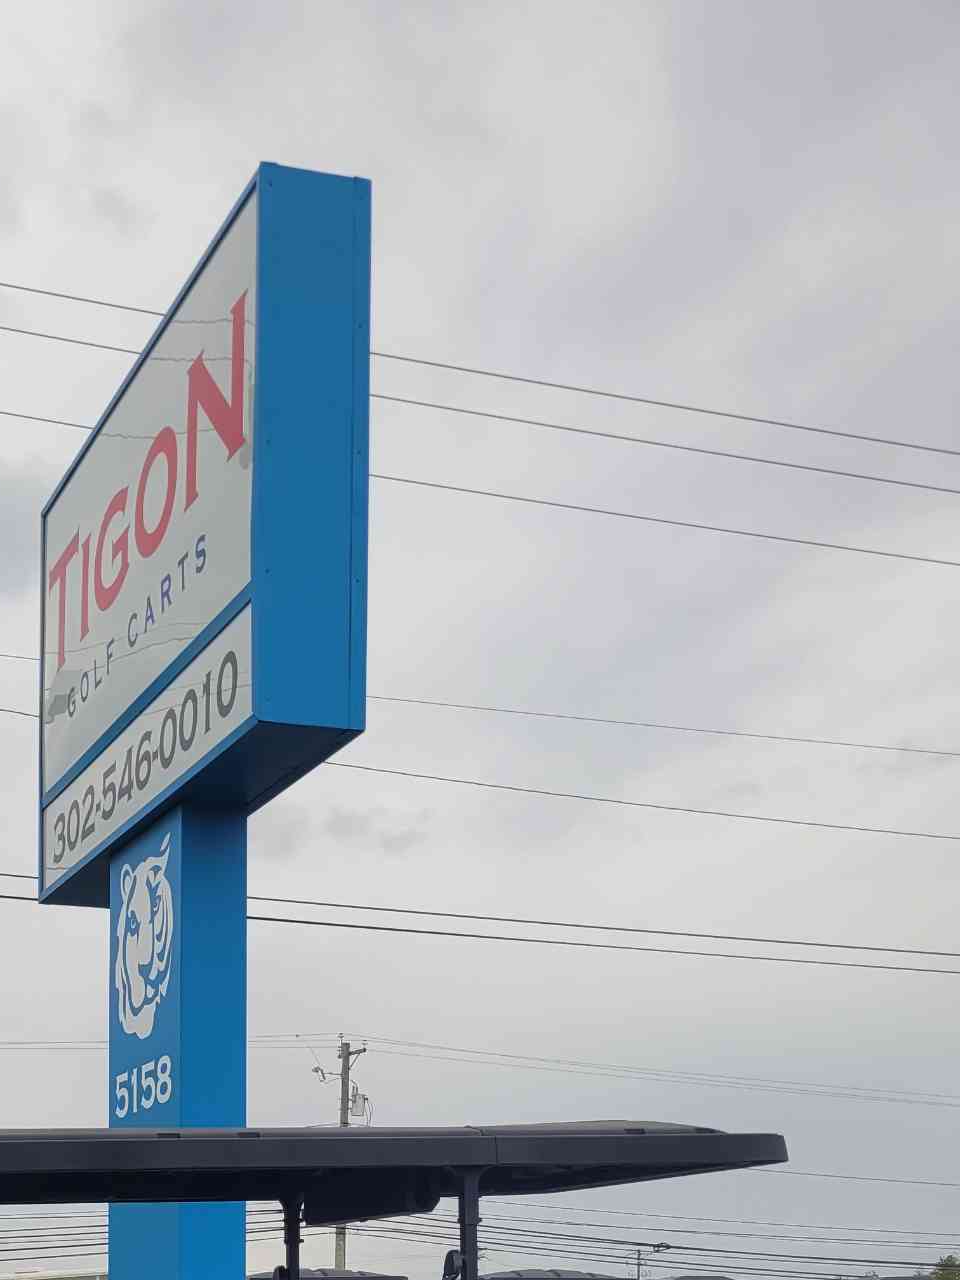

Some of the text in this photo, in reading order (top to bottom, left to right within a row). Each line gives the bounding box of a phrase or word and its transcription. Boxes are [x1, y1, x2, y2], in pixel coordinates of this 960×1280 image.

[48, 288, 248, 672] TIGON
[66, 534, 208, 718] GOLF CARTS
[114, 1055, 172, 1119] 5158
